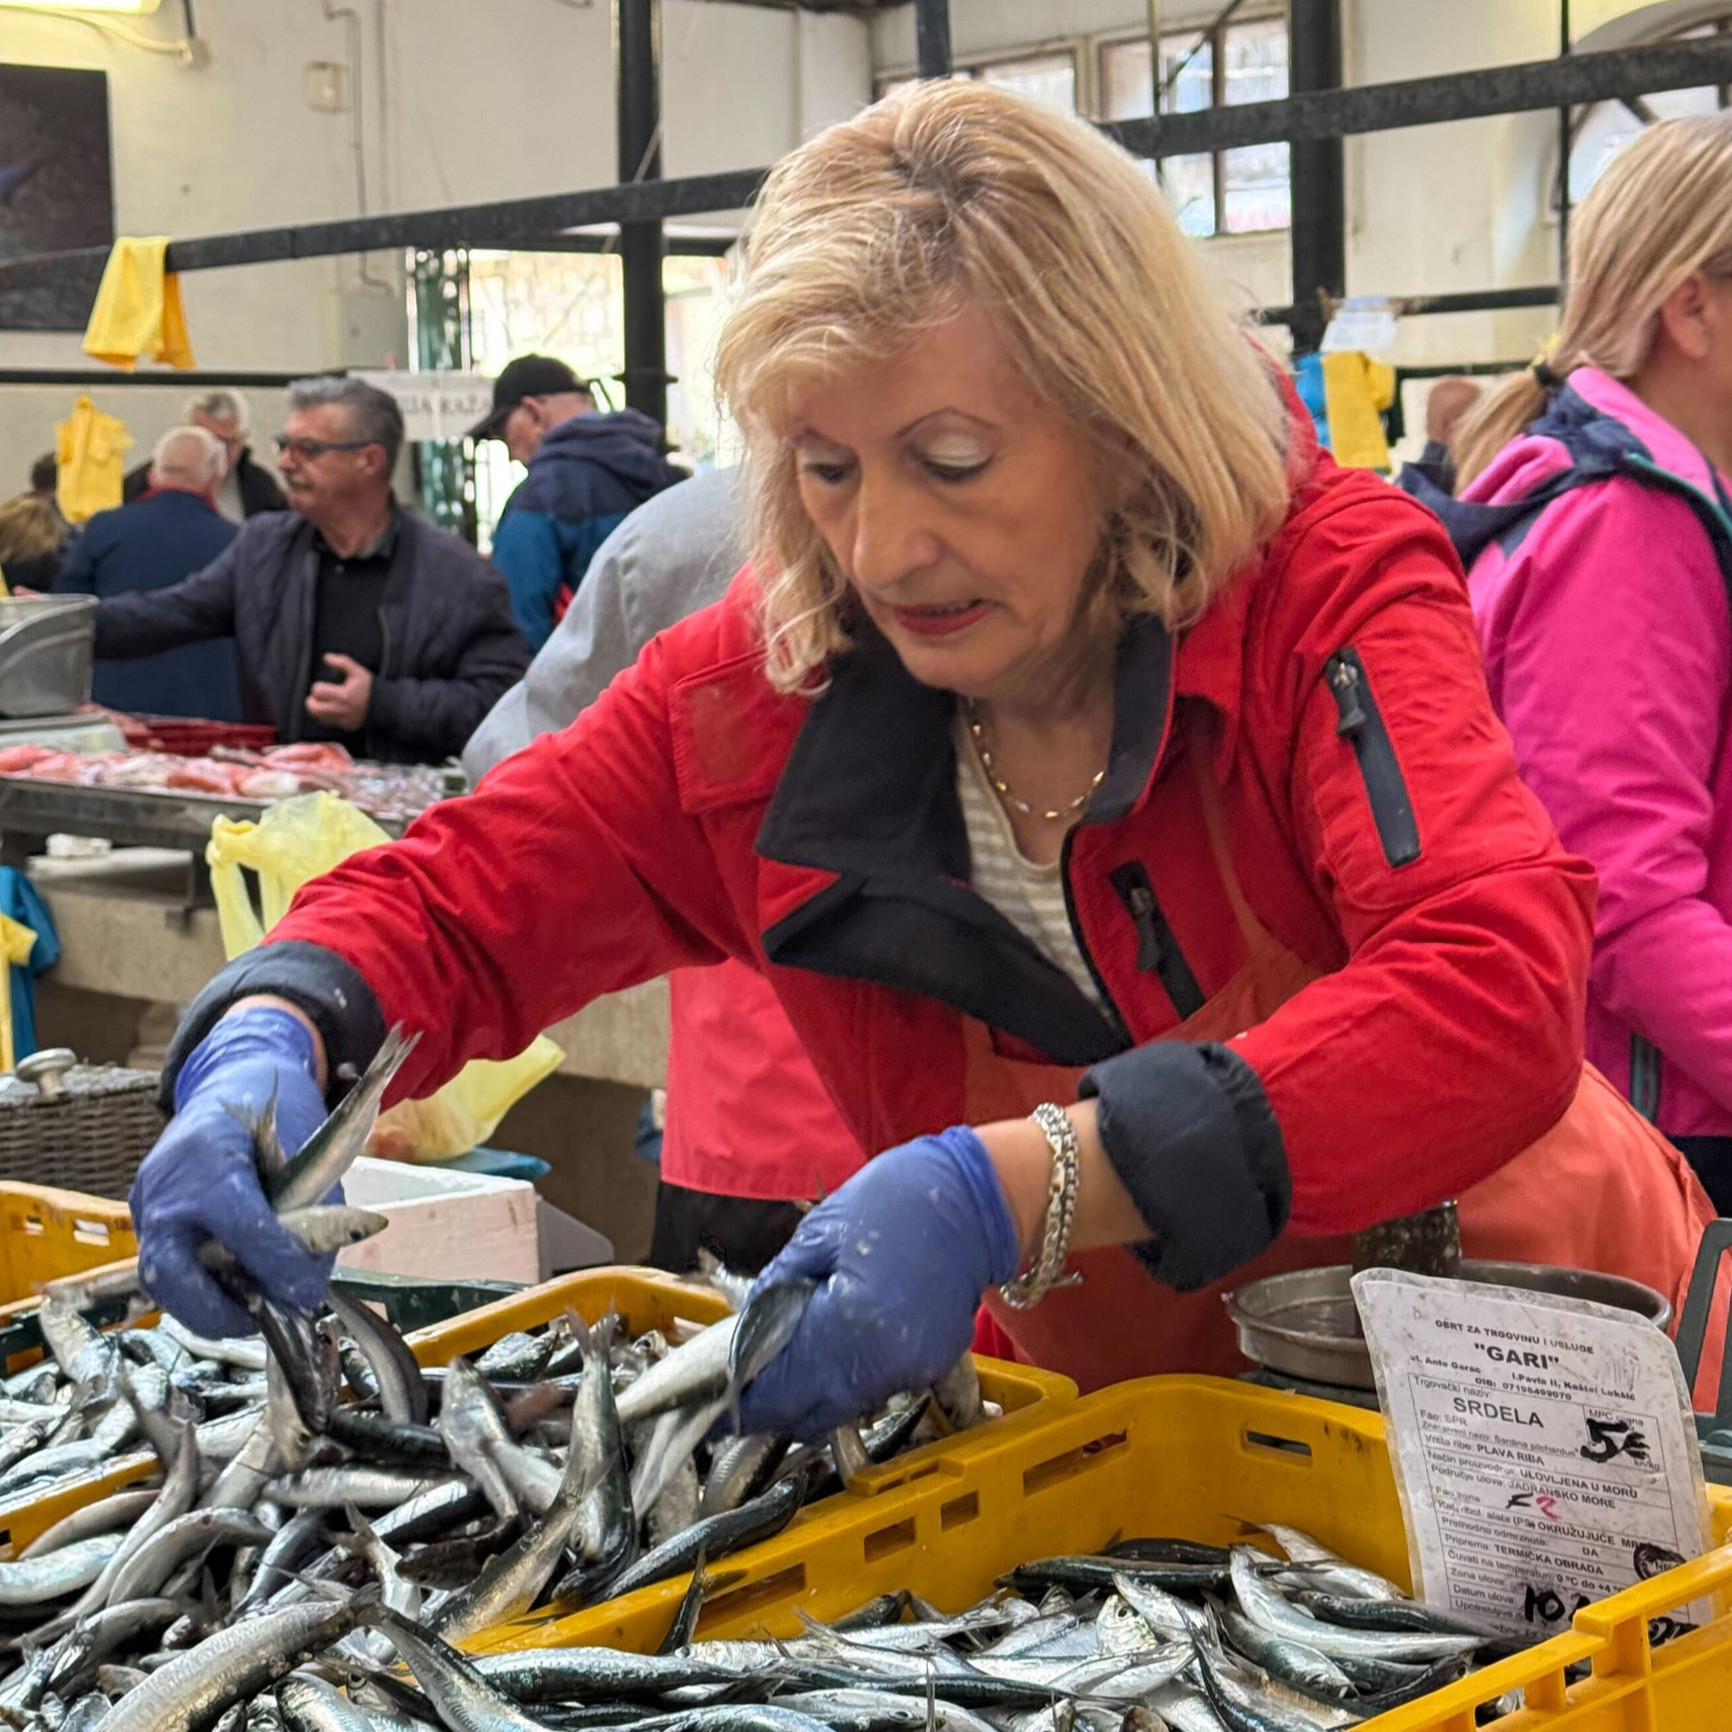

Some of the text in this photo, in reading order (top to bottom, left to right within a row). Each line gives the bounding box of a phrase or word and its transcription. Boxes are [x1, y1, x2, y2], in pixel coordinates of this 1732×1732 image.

[1435, 1319, 1595, 1355] OBRT ZA TRGOVINU I USLUGE
[1474, 1342, 1559, 1370] "GARI"
[1413, 1375, 1461, 1393] Trgovački
[1474, 1377, 1497, 1388] OIB:
[1453, 1396, 1545, 1429] SRDELA
[1588, 1408, 1614, 1421] MPC
[1476, 1443, 1515, 1460] PLAVA
[1517, 1451, 1545, 1466] RIBA
[1431, 1463, 1475, 1483] Područje
[1508, 1480, 1579, 1502] JADRANSKO
[1581, 1494, 1617, 1509] MORE
[1520, 1468, 1589, 1490] ULOVLJENA
[1591, 1481, 1600, 1492] U
[1602, 1483, 1639, 1500] MORU
[1441, 1516, 1492, 1535] Prethodno
[1582, 1546, 1599, 1558] DA
[1447, 1548, 1479, 1565] Čuvati
[1481, 1557, 1494, 1568] na
[1581, 1578, 1596, 1589] do
[1450, 1567, 1476, 1580] Zona
[1493, 1543, 1553, 1565] TERMIČKA
[1554, 1557, 1604, 1576] OBRADA
[1453, 1583, 1486, 1599] Datum
